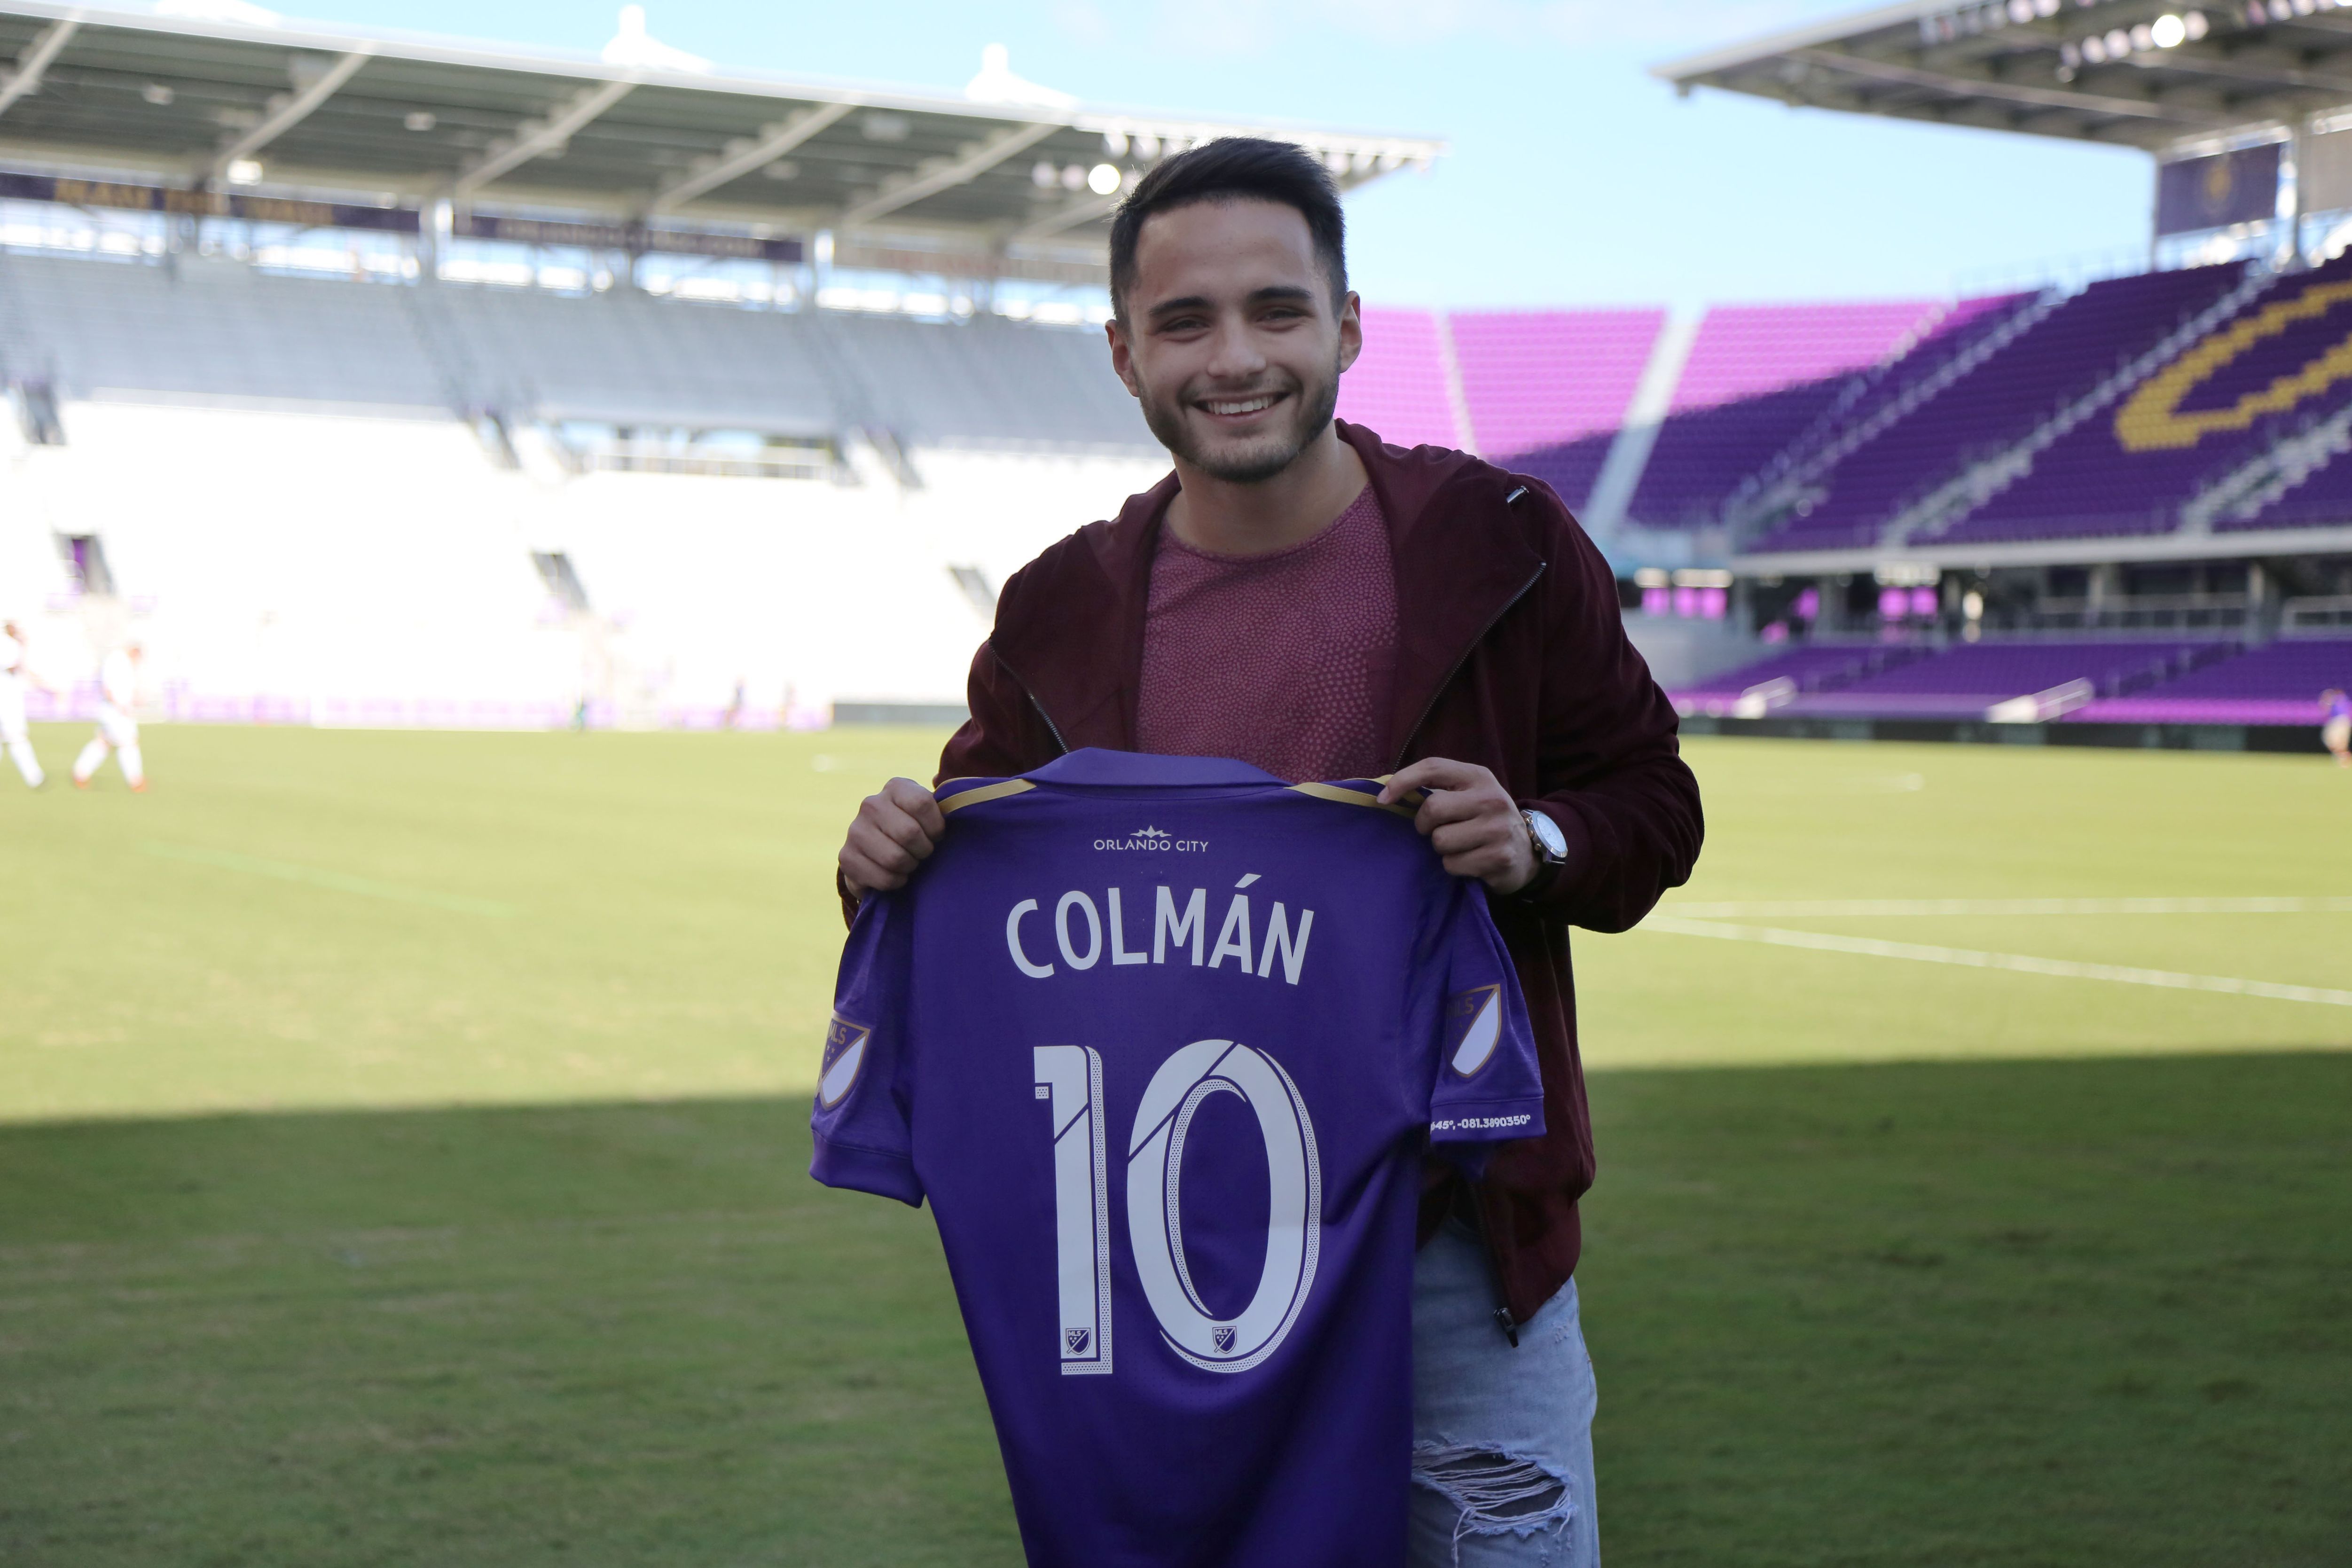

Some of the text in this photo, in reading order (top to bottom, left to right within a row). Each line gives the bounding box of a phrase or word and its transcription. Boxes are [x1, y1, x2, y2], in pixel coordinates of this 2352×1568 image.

[1094, 839, 1208, 852] ORLANDO CITY
[1006, 873, 1314, 986] COLMÁN
[1034, 1039, 1321, 1375] 10
